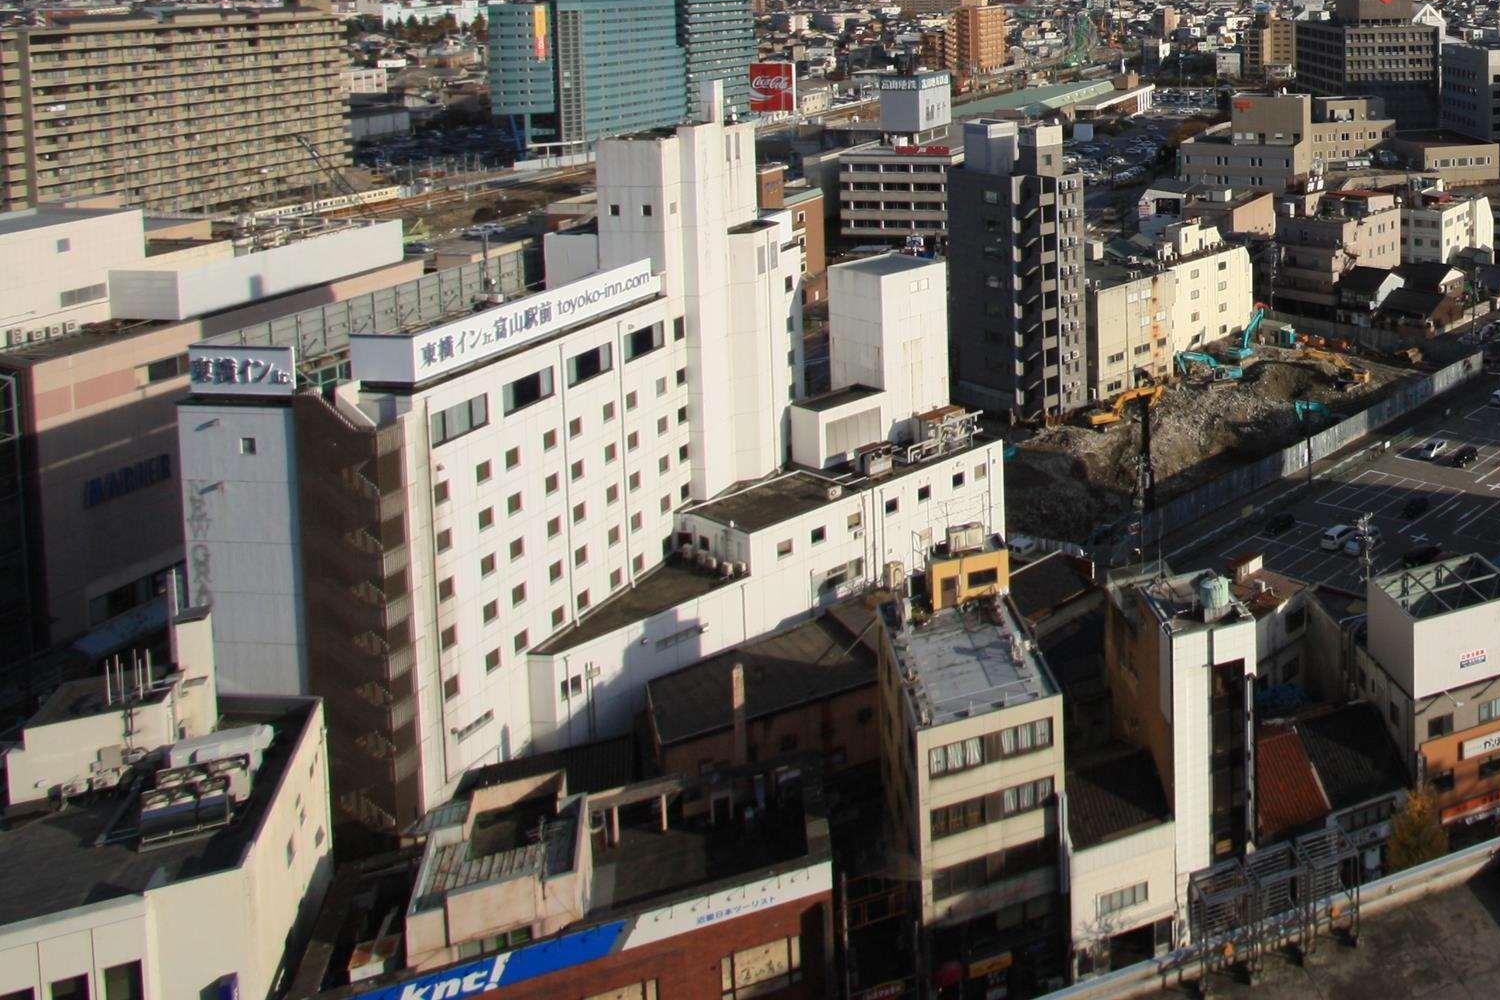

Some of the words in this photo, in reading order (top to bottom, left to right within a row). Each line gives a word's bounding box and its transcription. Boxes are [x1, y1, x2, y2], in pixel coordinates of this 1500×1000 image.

[494, 302, 552, 340] 富山駅前
[557, 272, 650, 315] toyoko-inn.com
